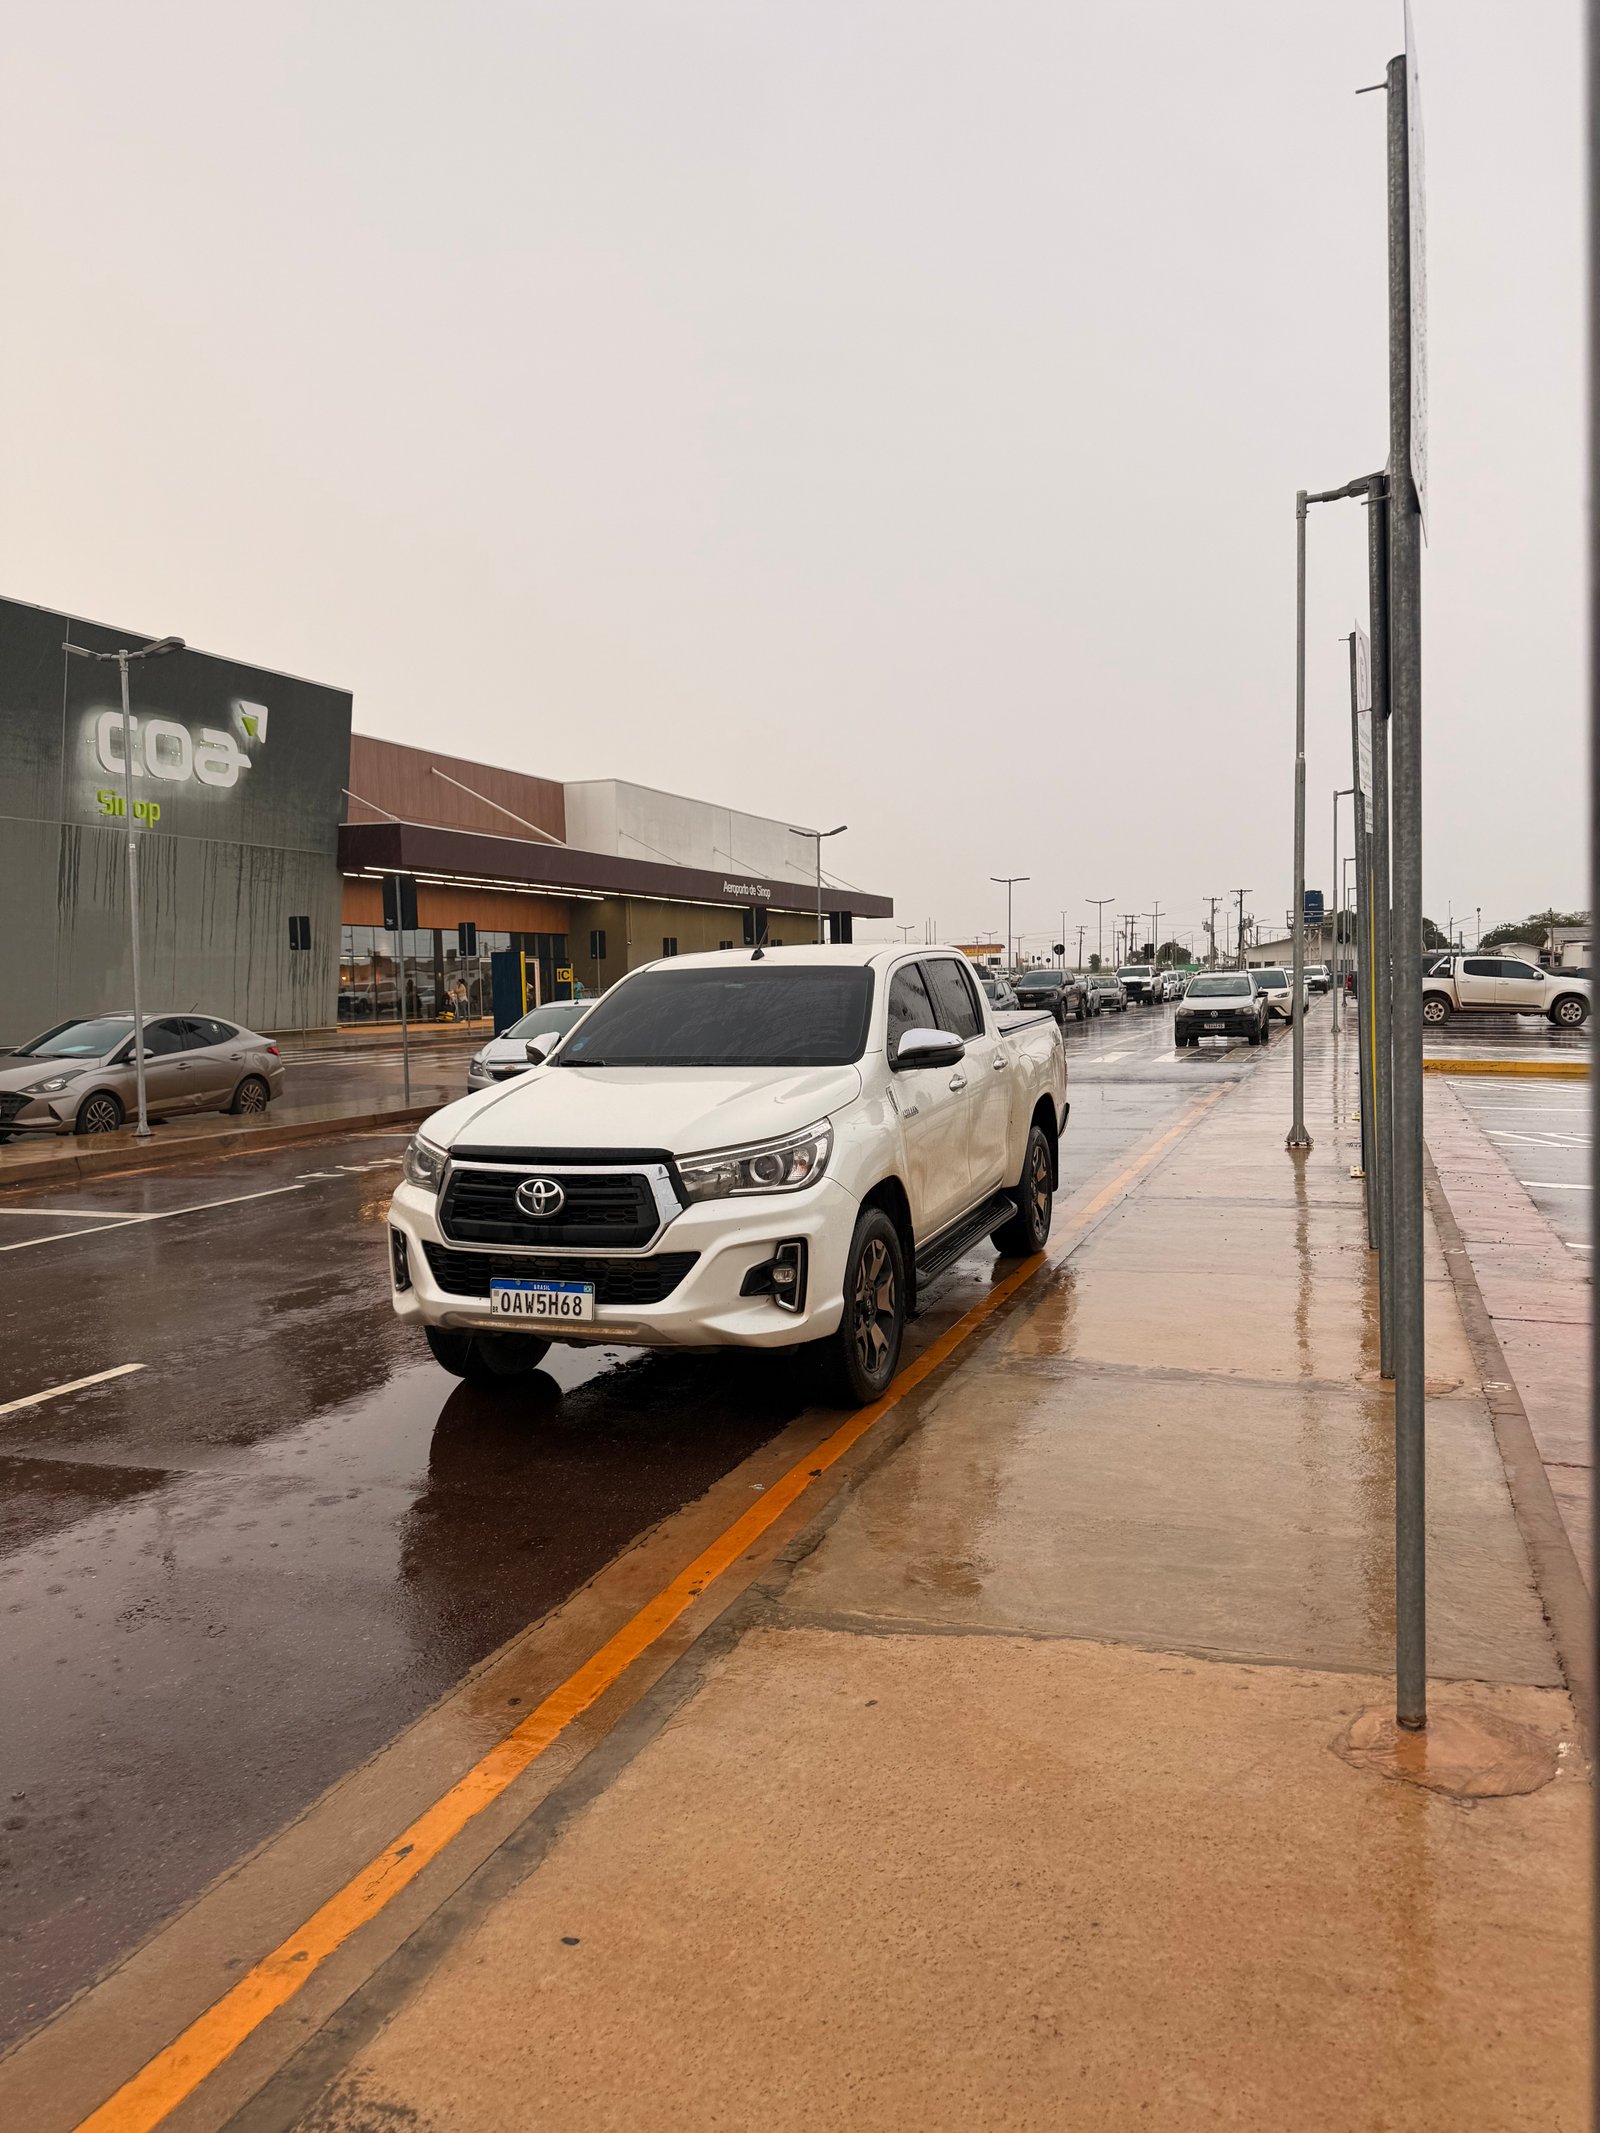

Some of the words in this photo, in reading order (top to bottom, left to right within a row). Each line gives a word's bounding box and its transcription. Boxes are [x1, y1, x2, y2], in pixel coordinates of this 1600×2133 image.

[97, 711, 252, 788] coa
[723, 880, 748, 896] Aeroporto
[749, 884, 756, 896] de
[756, 885, 771, 900] Sinop
